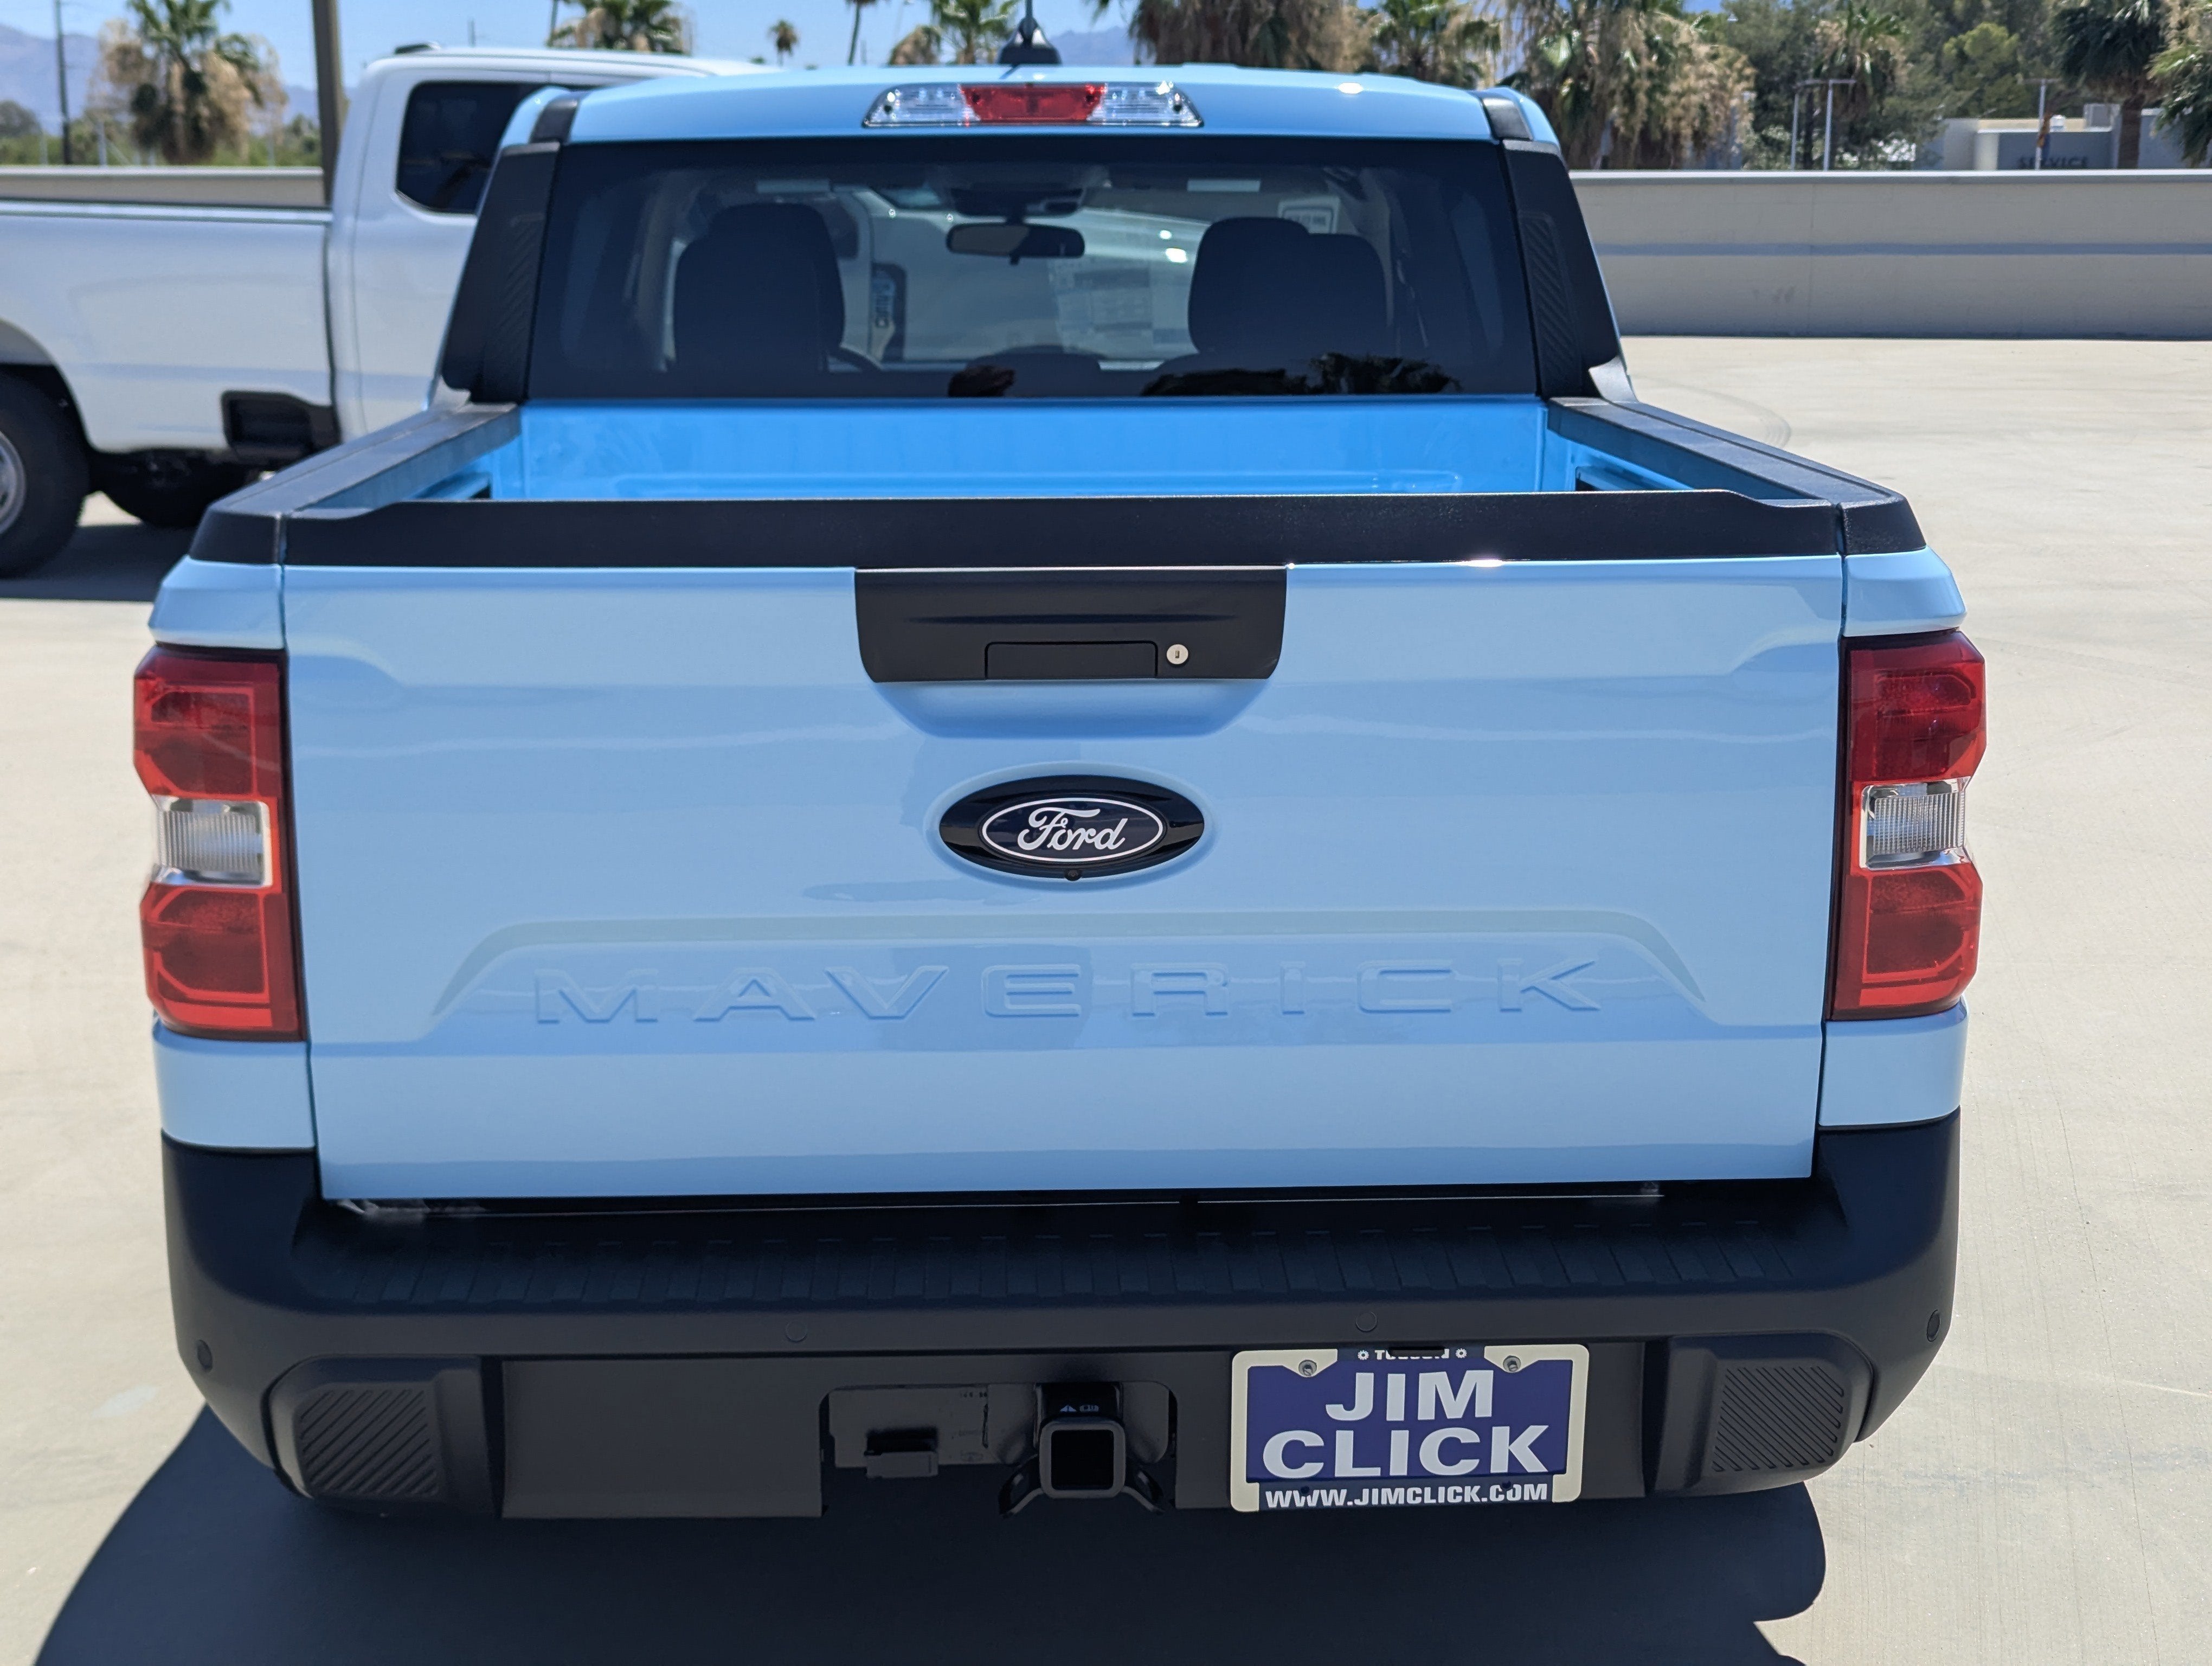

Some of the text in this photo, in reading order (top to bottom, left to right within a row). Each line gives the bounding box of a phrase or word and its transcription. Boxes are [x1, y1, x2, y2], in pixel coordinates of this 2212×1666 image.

[1017, 807, 1128, 850] Ford
[535, 958, 1600, 1023] MAVERICK
[1326, 1370, 1494, 1421] JIM
[1263, 1425, 1549, 1479] CLICK
[1265, 1484, 1547, 1508] WWW.JIMCLICK.COM
